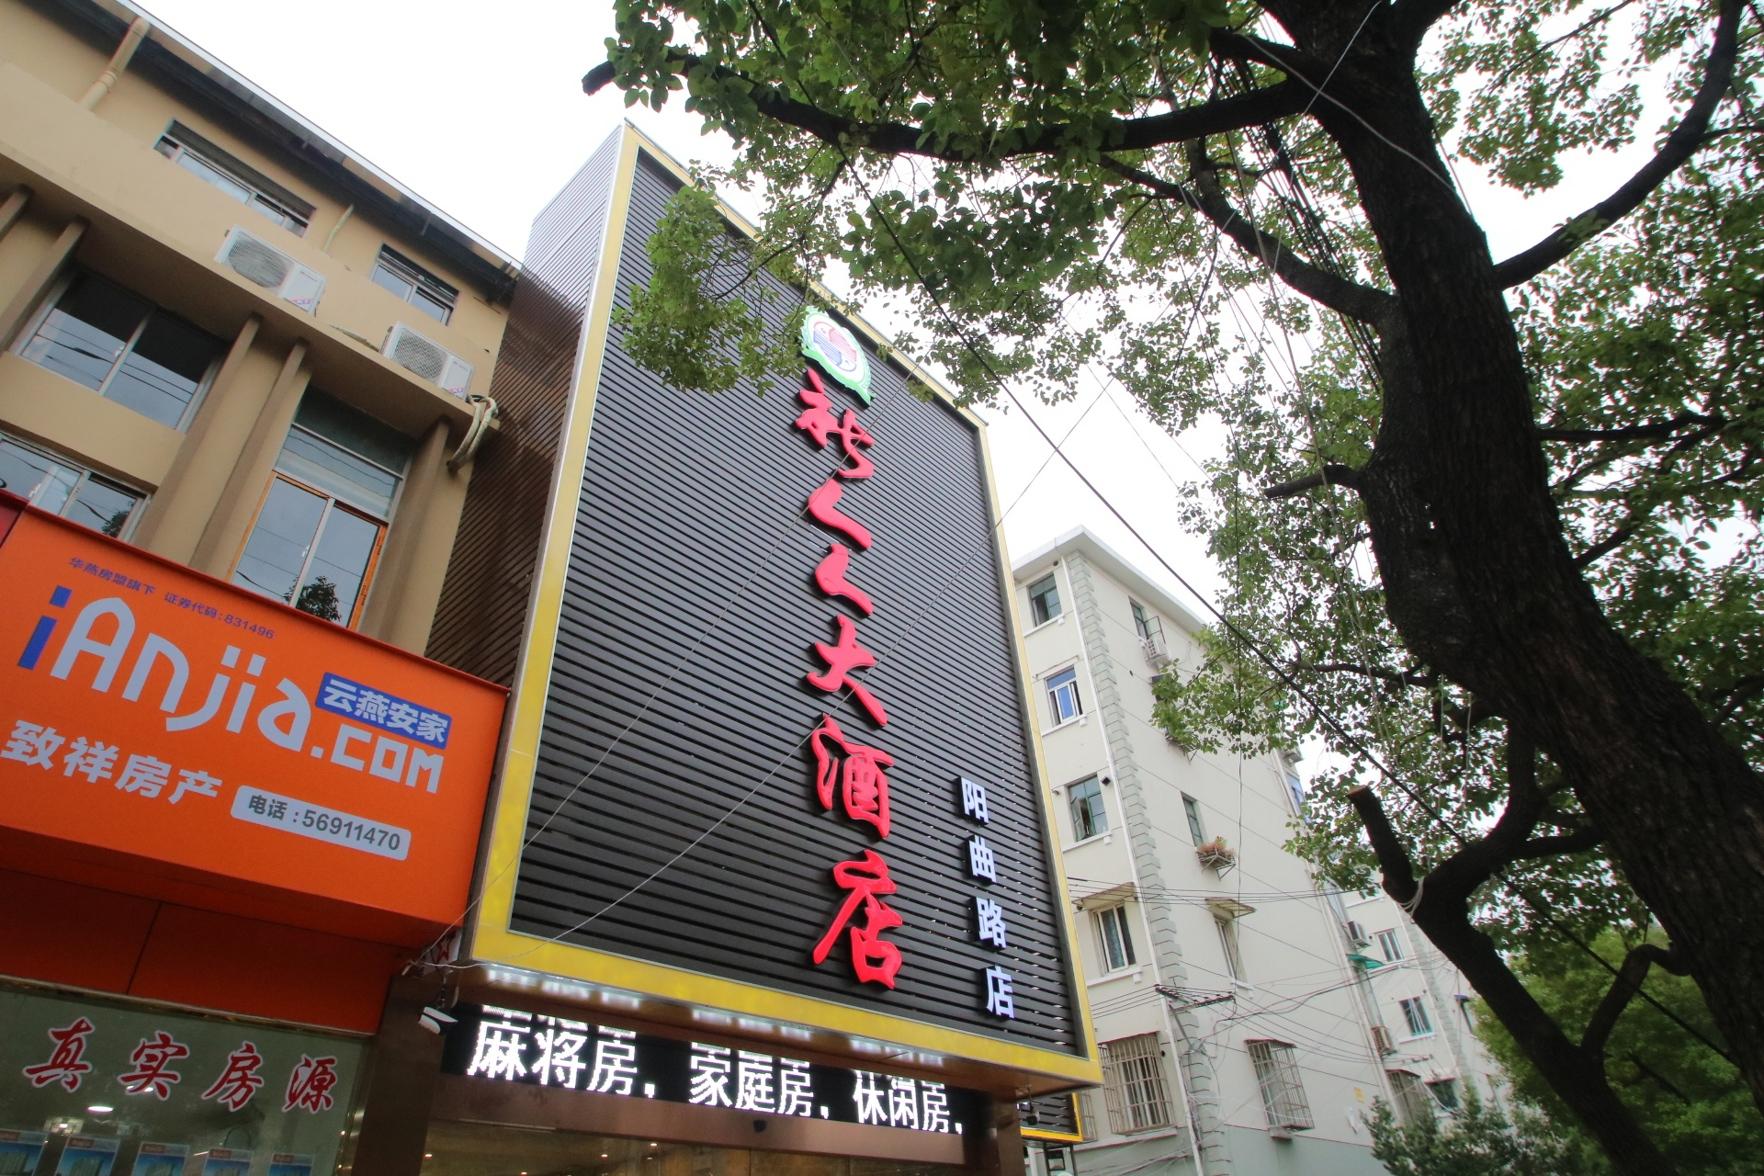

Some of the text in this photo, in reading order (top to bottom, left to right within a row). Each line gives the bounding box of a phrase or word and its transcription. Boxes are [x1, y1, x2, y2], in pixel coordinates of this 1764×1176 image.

[323, 678, 449, 743] 云燕安家
[0, 719, 223, 806] 致祥房产
[960, 776, 1015, 1020] 阳曲路店
[22, 1016, 338, 1113] 真实房源
